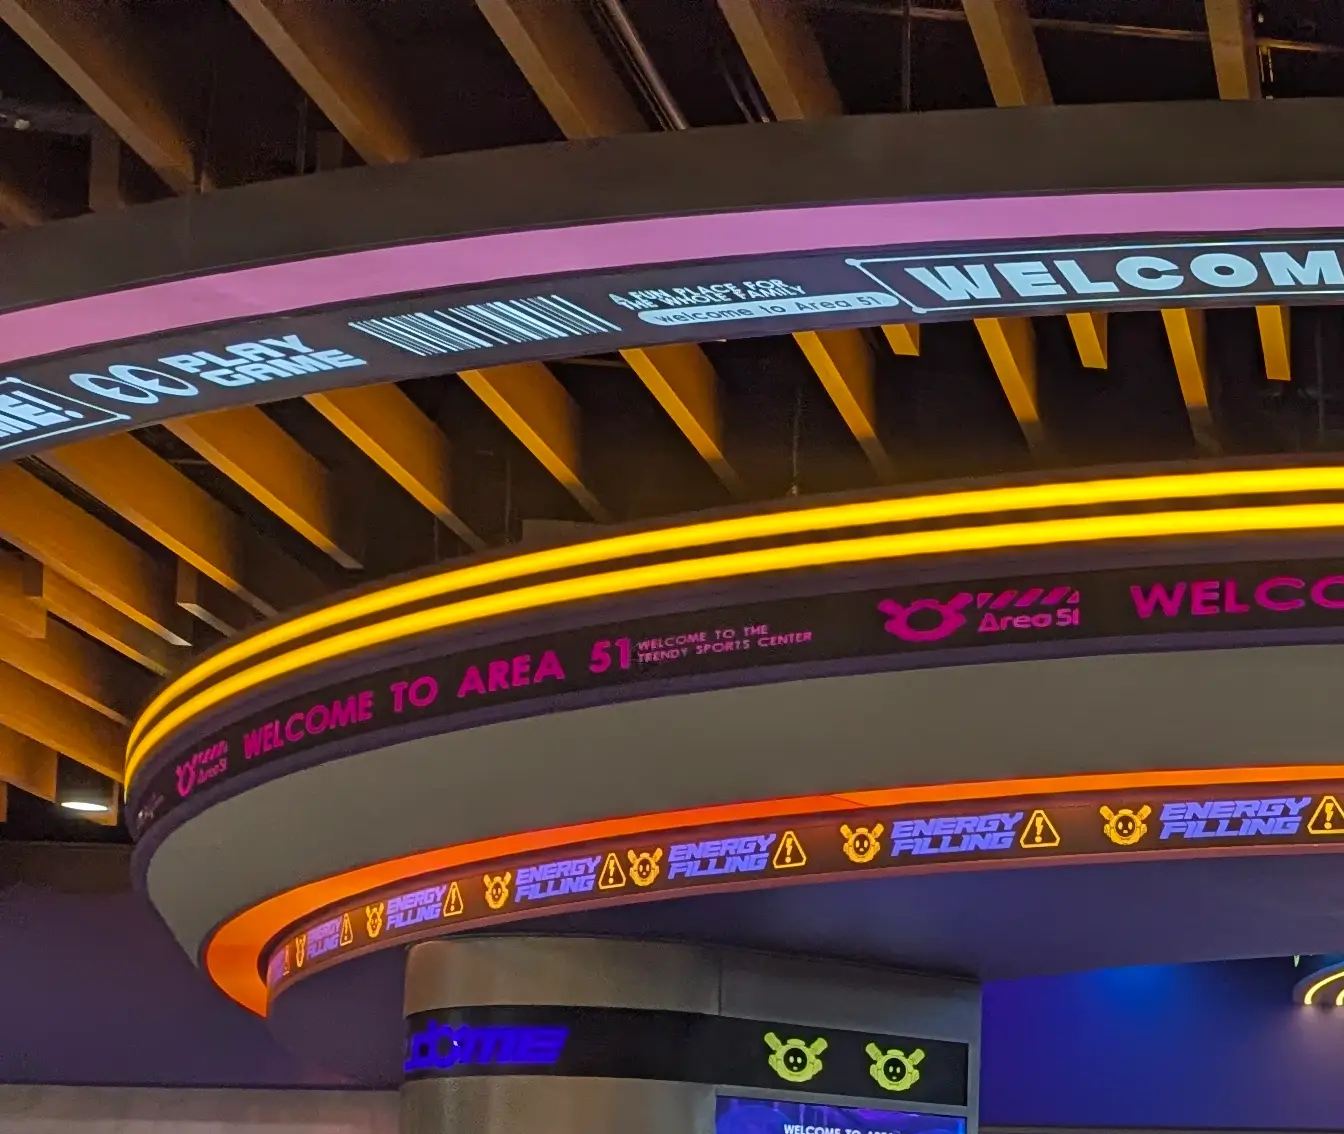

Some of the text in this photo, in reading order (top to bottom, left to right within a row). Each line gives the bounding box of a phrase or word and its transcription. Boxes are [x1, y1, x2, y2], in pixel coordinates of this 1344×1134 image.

[652, 295, 883, 325] welcome to Area 51
[158, 333, 316, 374] PLAY
[199, 349, 367, 388] GAME
[977, 607, 1080, 634] Area 51
[637, 624, 768, 651] WELCOME TO THE
[696, 640, 751, 656] SPORTS
[757, 631, 813, 648] CENTER
[242, 638, 631, 760] WELCOME TO AREA 51
[1160, 796, 1312, 822] ENERGY
[891, 812, 1024, 840] ENERGY
[1158, 816, 1304, 840] FILLING
[669, 833, 776, 862] ENERGY
[891, 830, 1015, 857] FILLING
[515, 855, 602, 886] ENERGY
[667, 854, 770, 880] FILLING
[515, 874, 595, 903] FILLING
